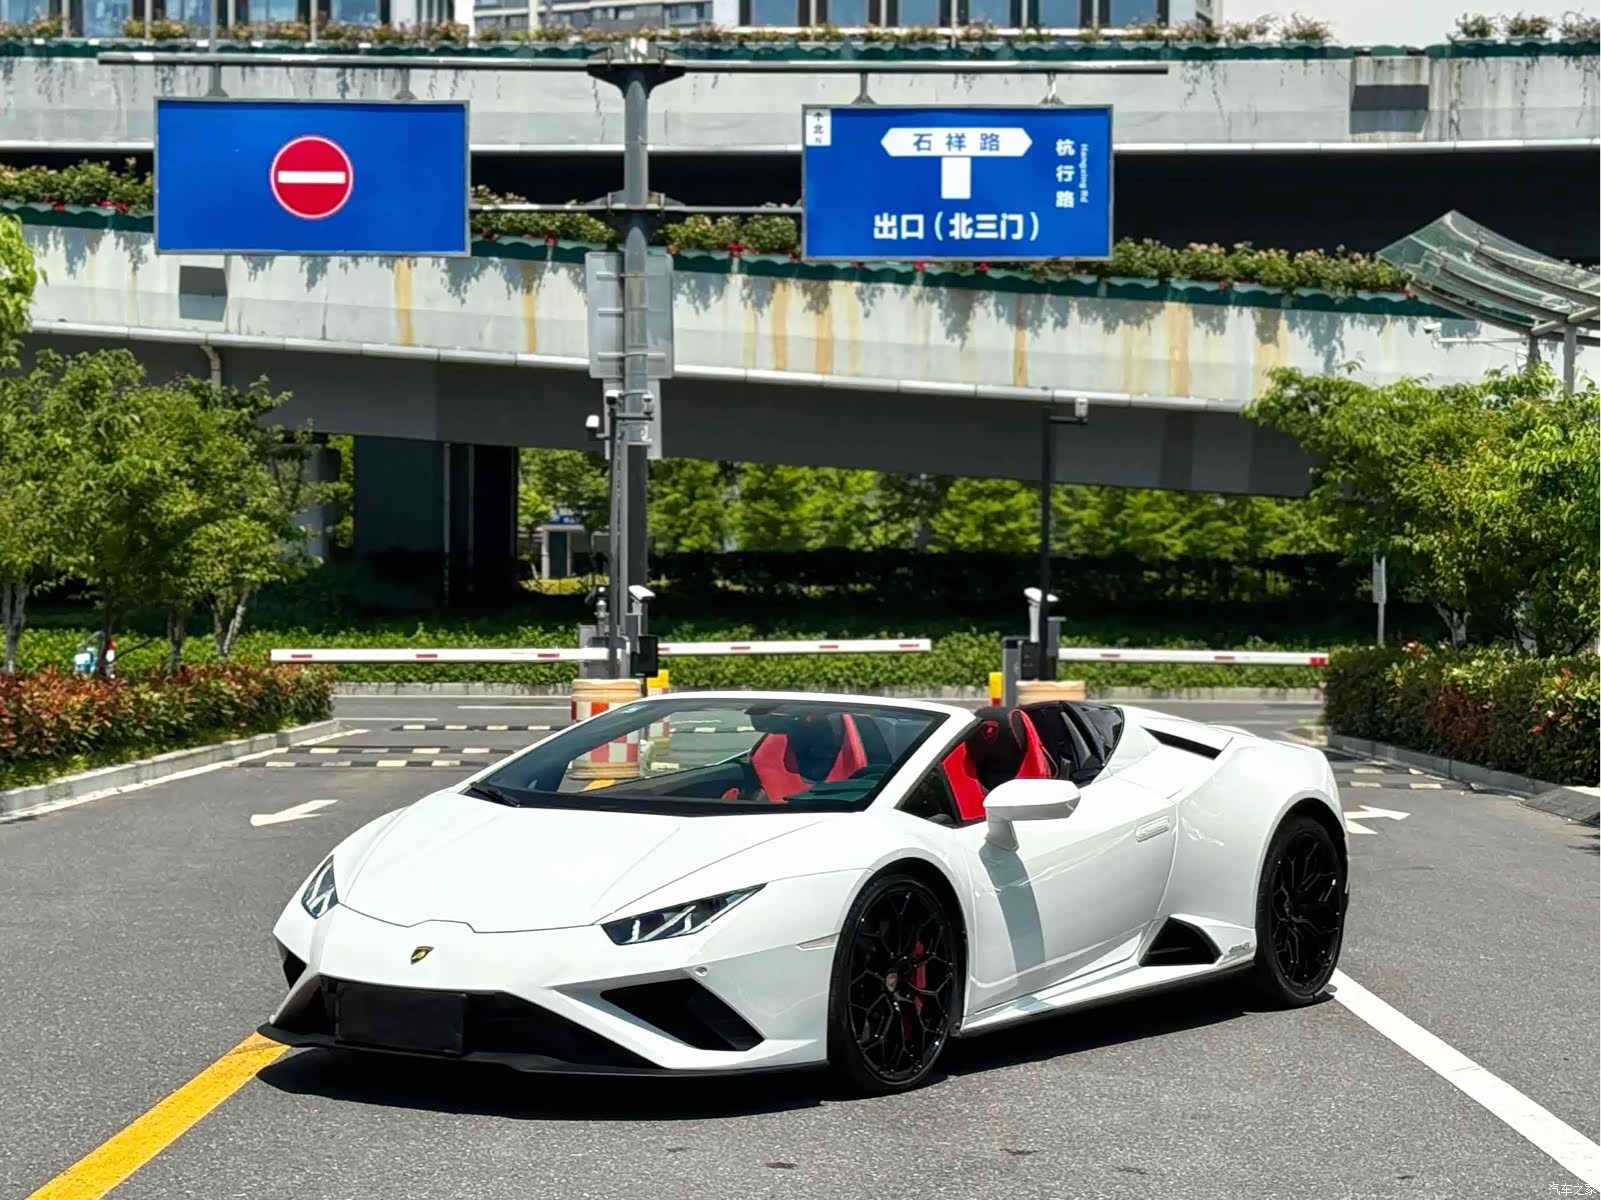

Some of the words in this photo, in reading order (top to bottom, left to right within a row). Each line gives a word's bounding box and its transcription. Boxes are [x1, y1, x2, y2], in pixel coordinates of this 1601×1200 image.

[912, 132, 1001, 153] 石祥路
[1056, 138, 1075, 208] 杭行路
